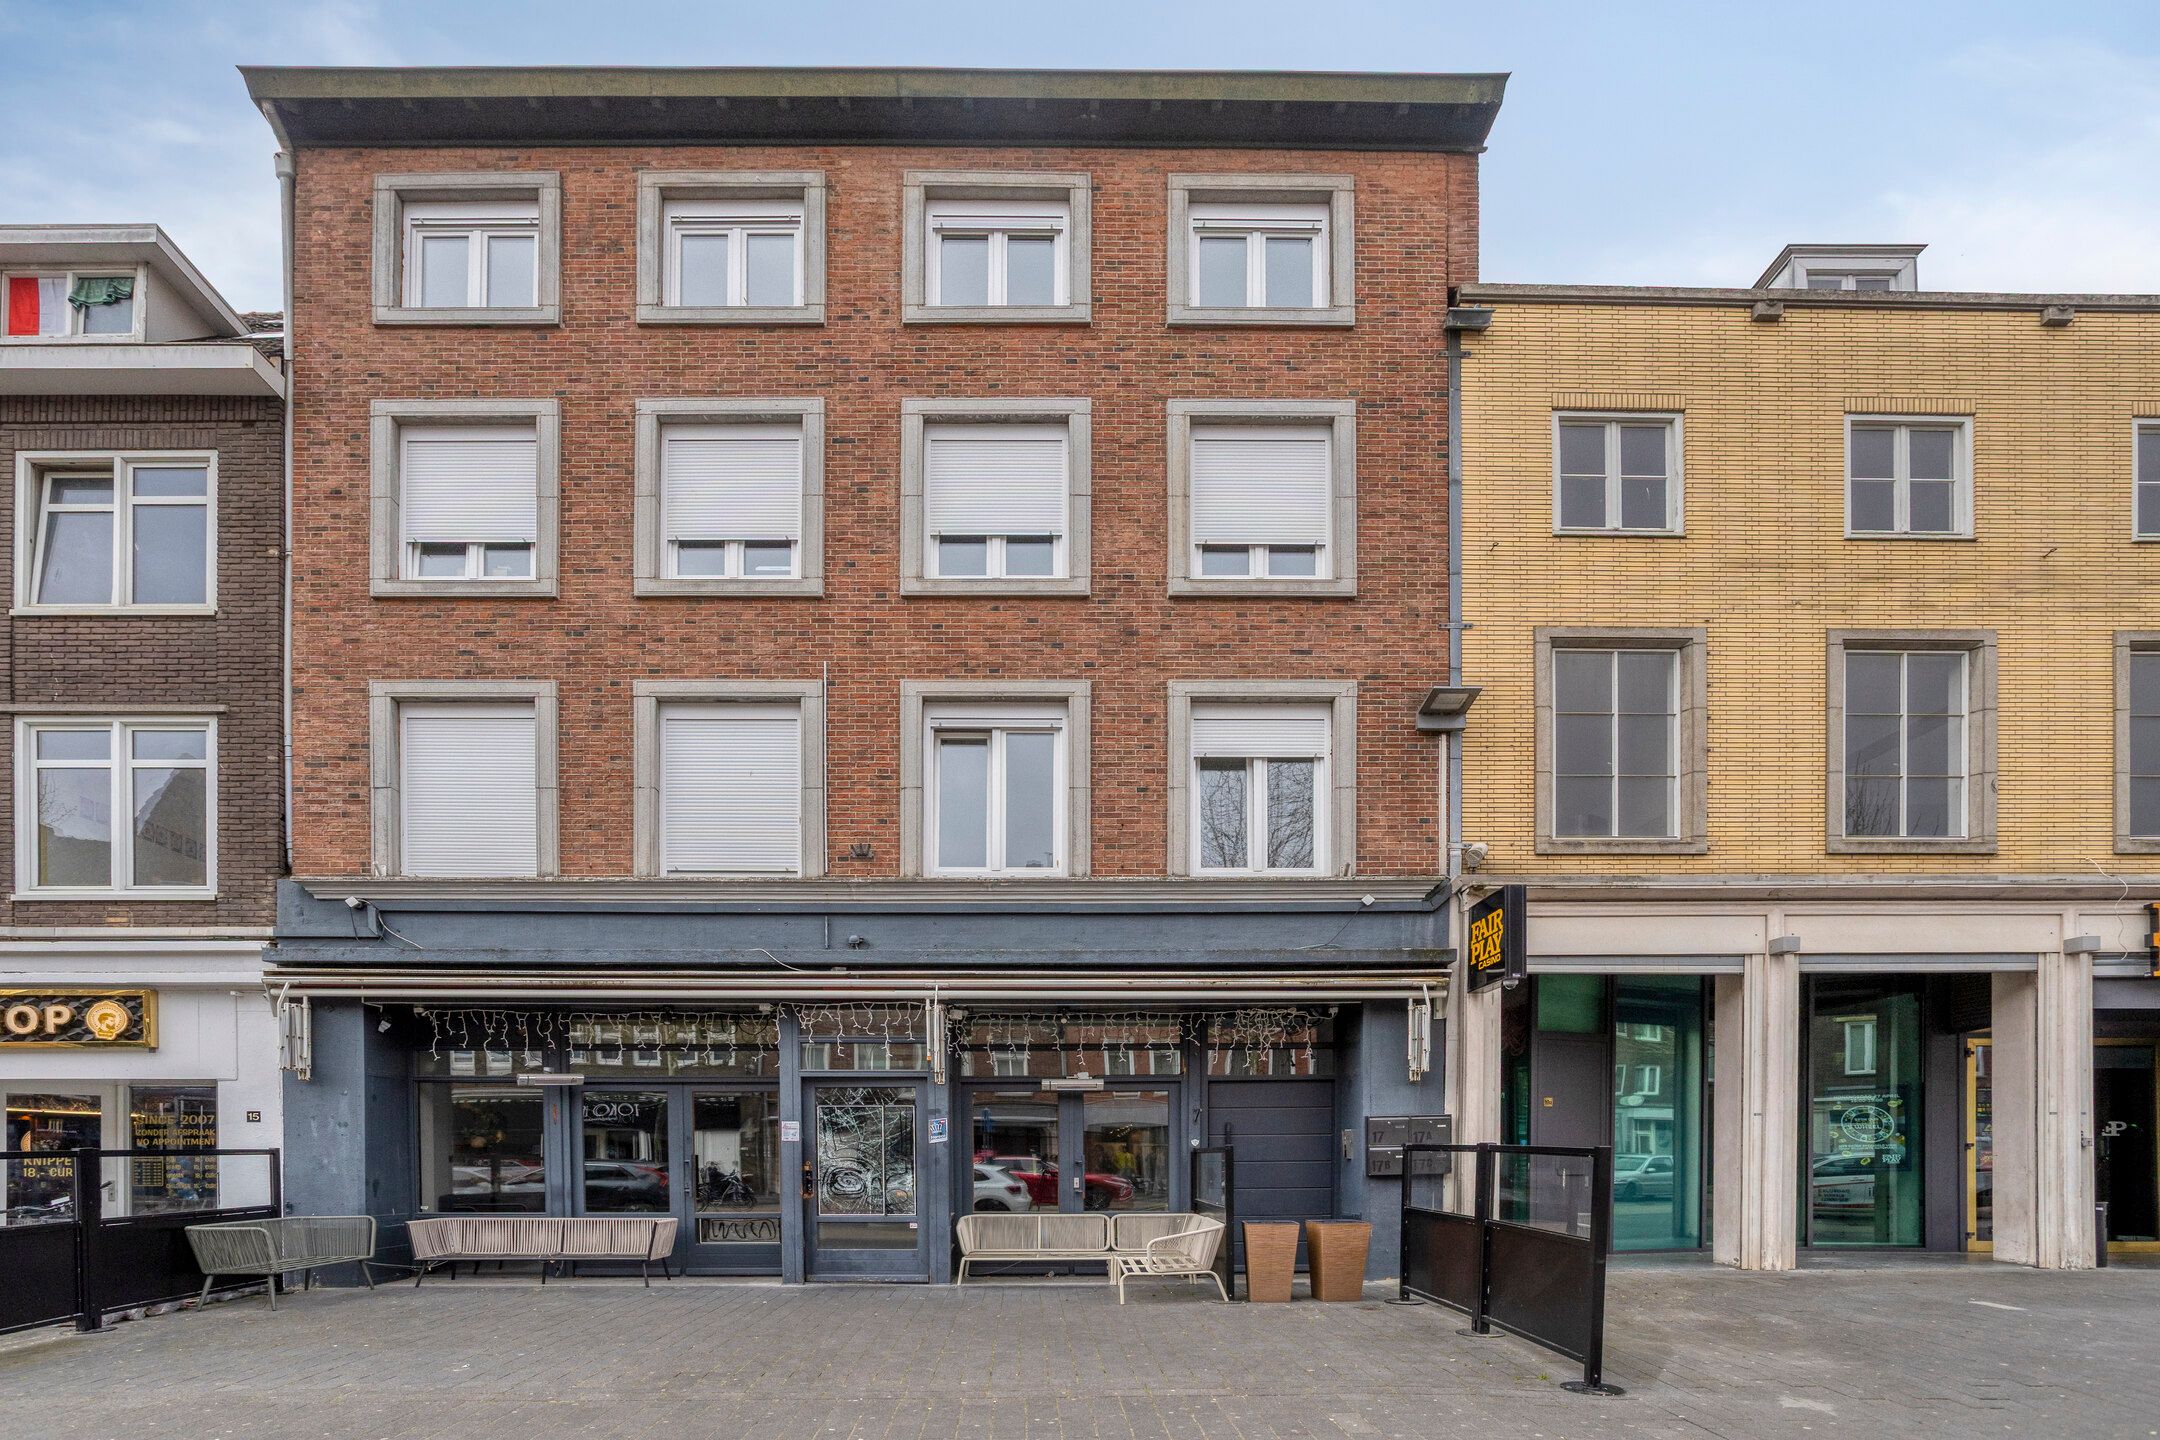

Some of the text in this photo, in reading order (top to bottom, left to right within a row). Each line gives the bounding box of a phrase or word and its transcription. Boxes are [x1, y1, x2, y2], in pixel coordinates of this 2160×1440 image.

[1471, 908, 1503, 942] FAIR
[1471, 929, 1503, 965] PLAY
[1478, 953, 1501, 970] CASINO
[136, 1114, 215, 1125] SINCE 2007
[247, 1112, 260, 1121] 15
[136, 1128, 216, 1136] ZONDER AFSPRAAK
[1372, 1130, 1385, 1143] 17
[136, 1138, 216, 1146] NO APPOINTMENT
